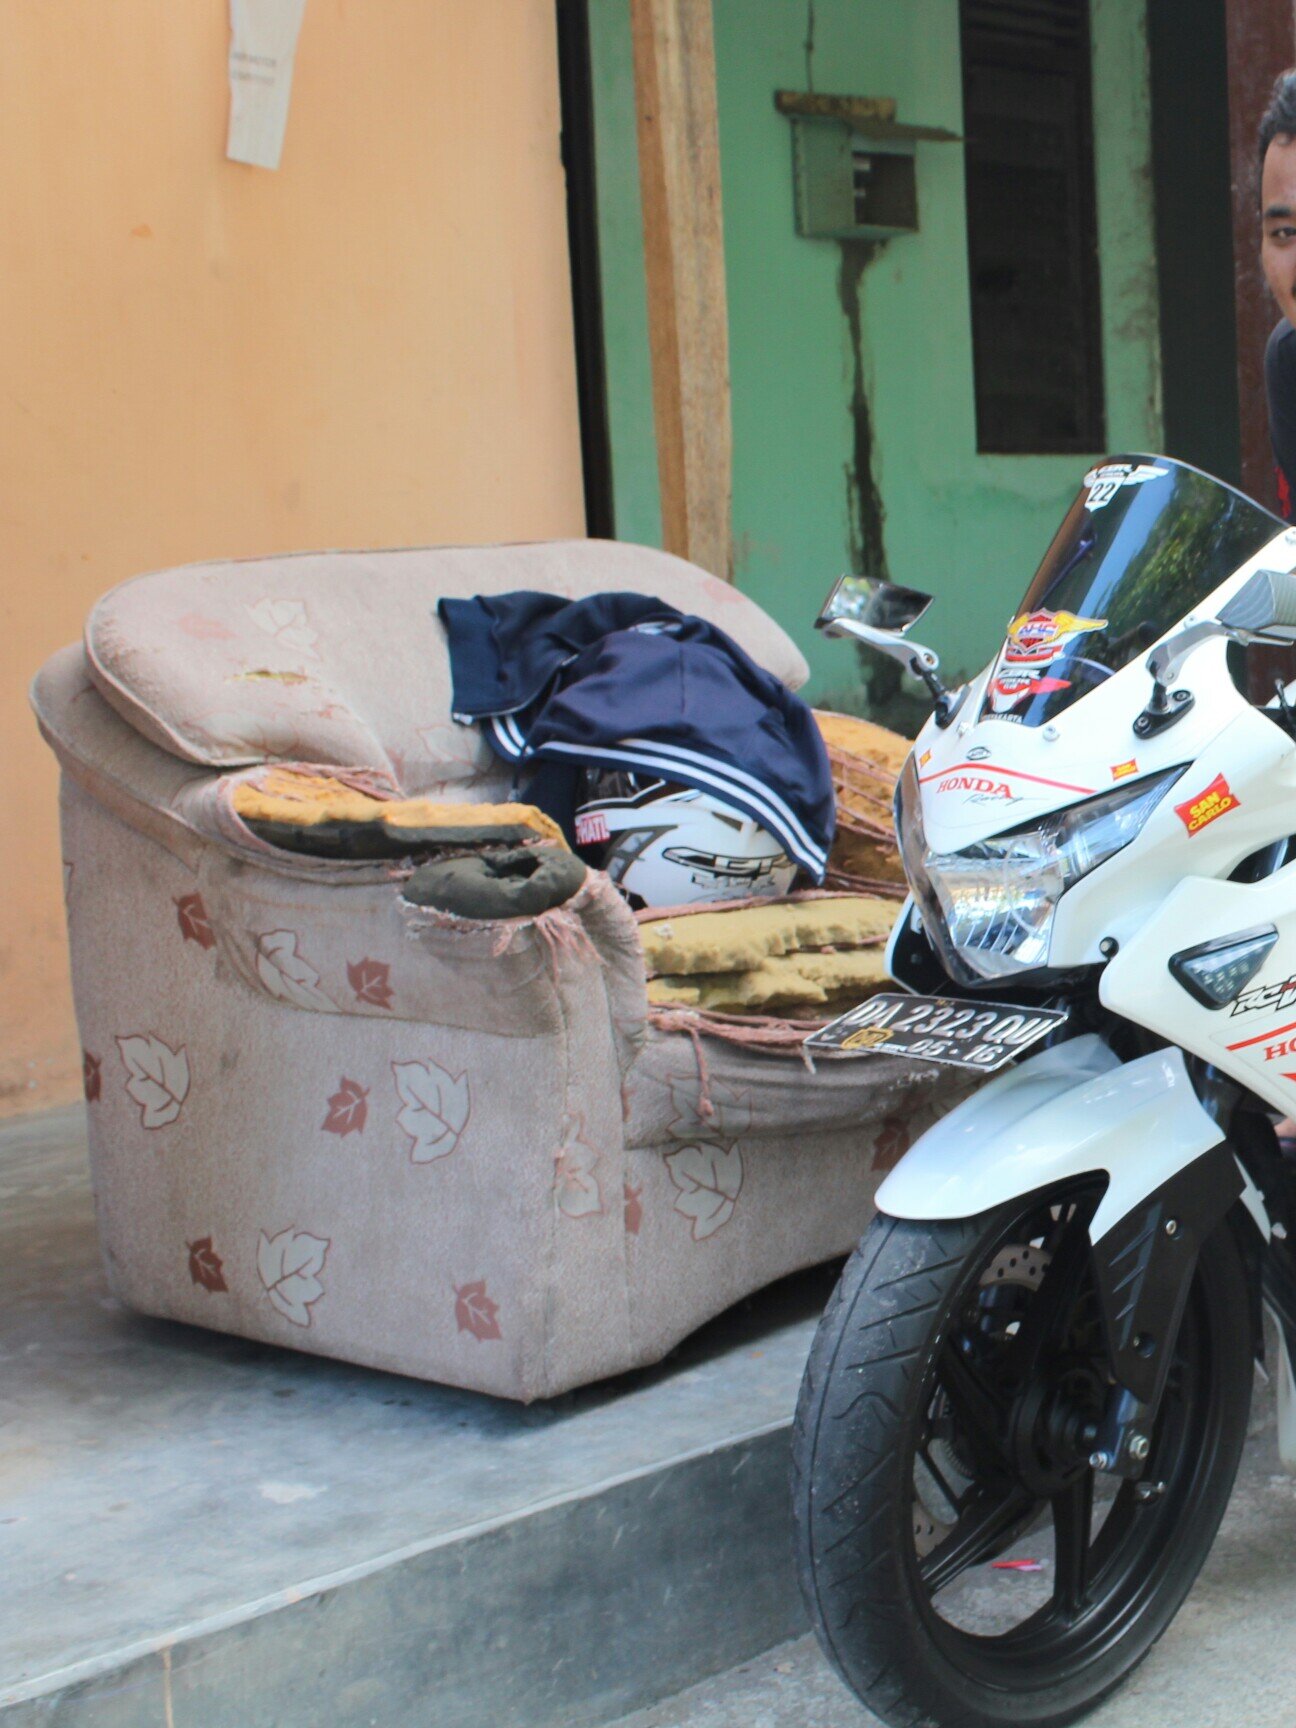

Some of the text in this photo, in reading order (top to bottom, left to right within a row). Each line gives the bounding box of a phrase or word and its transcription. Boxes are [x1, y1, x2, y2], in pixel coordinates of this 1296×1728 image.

[1088, 482, 1116, 503] 22
[936, 777, 1013, 799] HONDA
[1188, 796, 1232, 831] CARLO
[1189, 790, 1221, 819] SAN
[889, 1004, 999, 1040] 2323
[906, 1038, 954, 1057] 05
